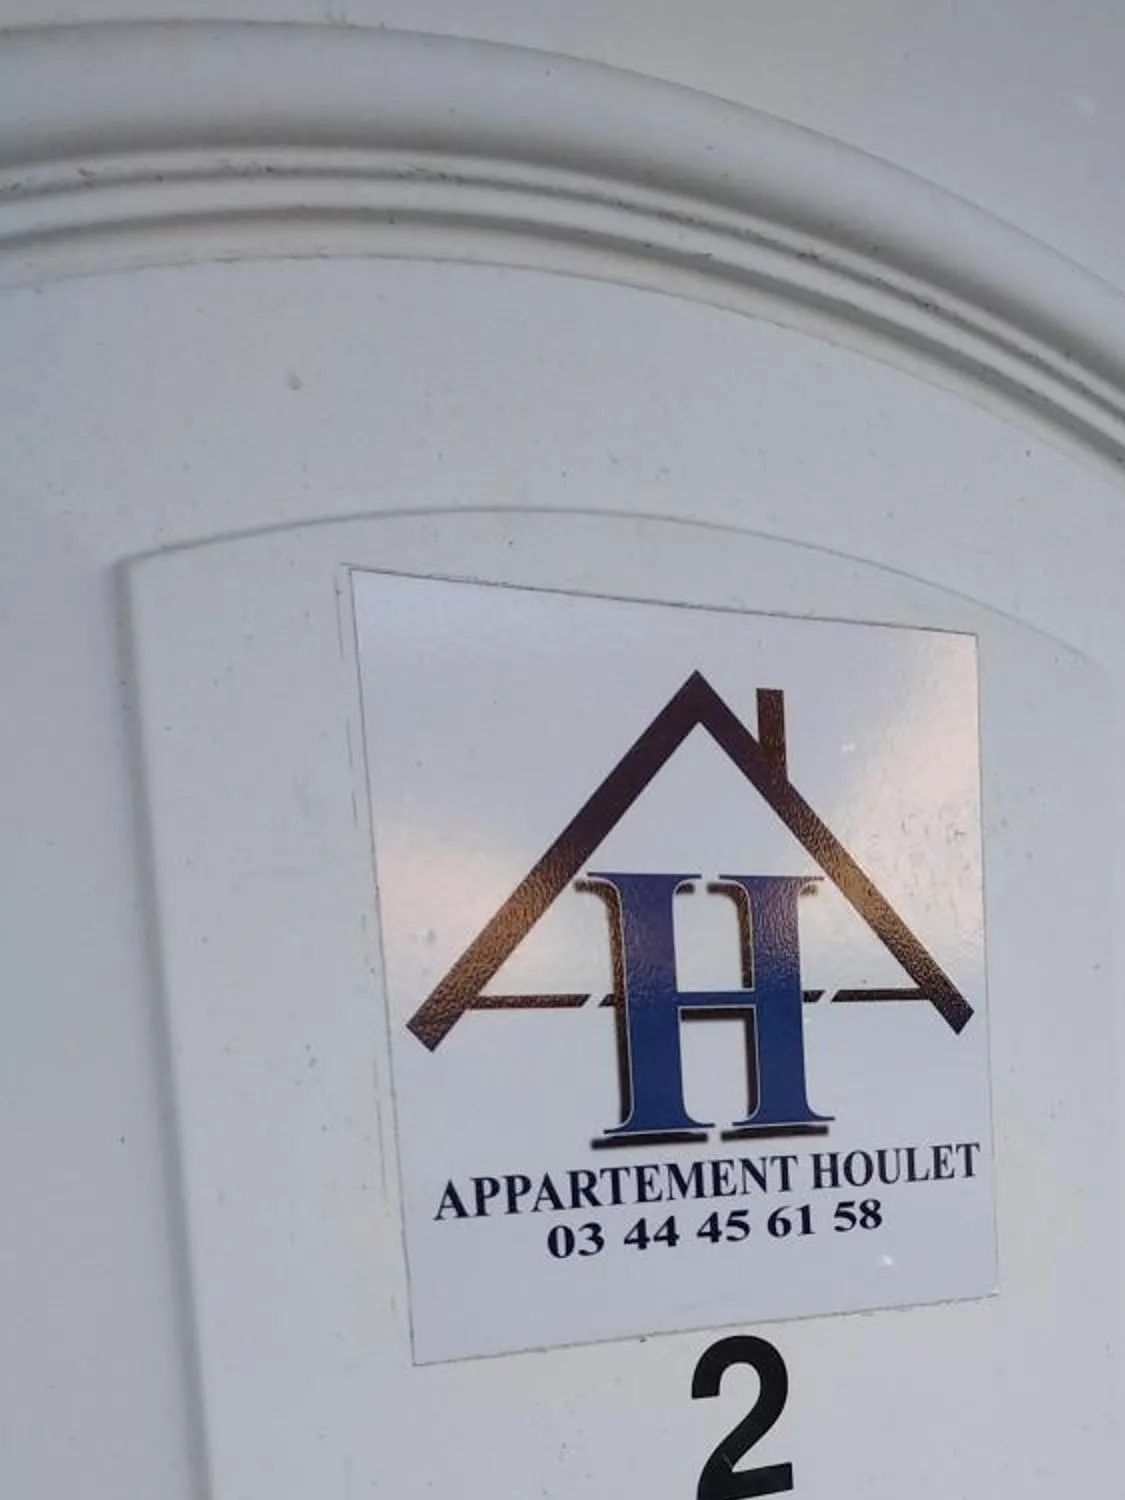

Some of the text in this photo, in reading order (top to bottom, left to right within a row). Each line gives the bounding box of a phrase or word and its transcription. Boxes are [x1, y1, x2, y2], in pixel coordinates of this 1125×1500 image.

[434, 1143, 981, 1221] APPARTEMENT HOULET
[546, 1197, 884, 1259] 03 44 45 61 58
